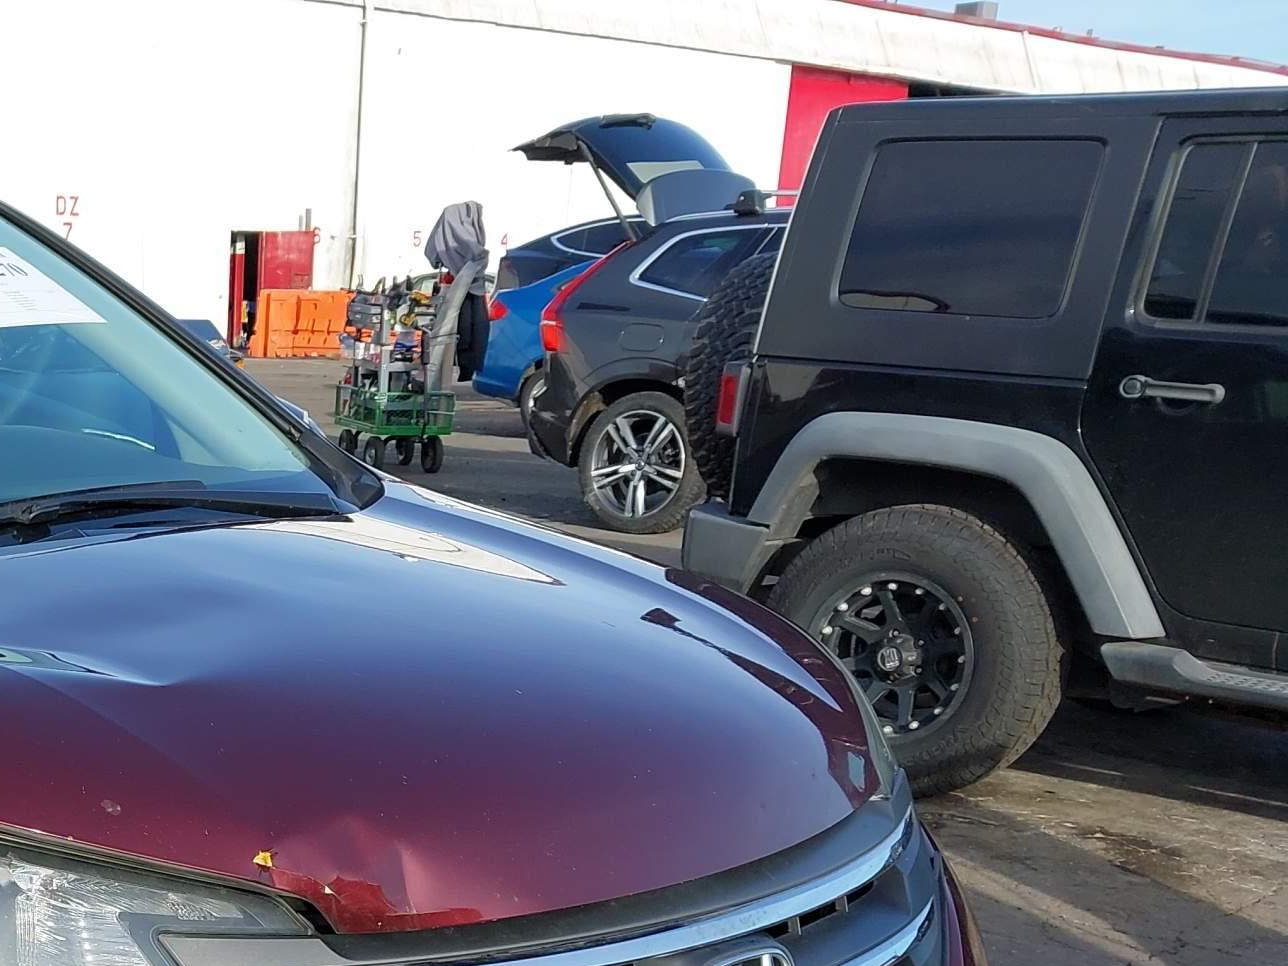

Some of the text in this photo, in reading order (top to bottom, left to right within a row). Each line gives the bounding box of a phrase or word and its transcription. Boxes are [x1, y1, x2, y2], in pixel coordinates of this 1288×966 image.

[56, 195, 79, 216] DZ
[63, 222, 72, 240] 7
[413, 230, 422, 247] 5
[500, 232, 508, 249] 4
